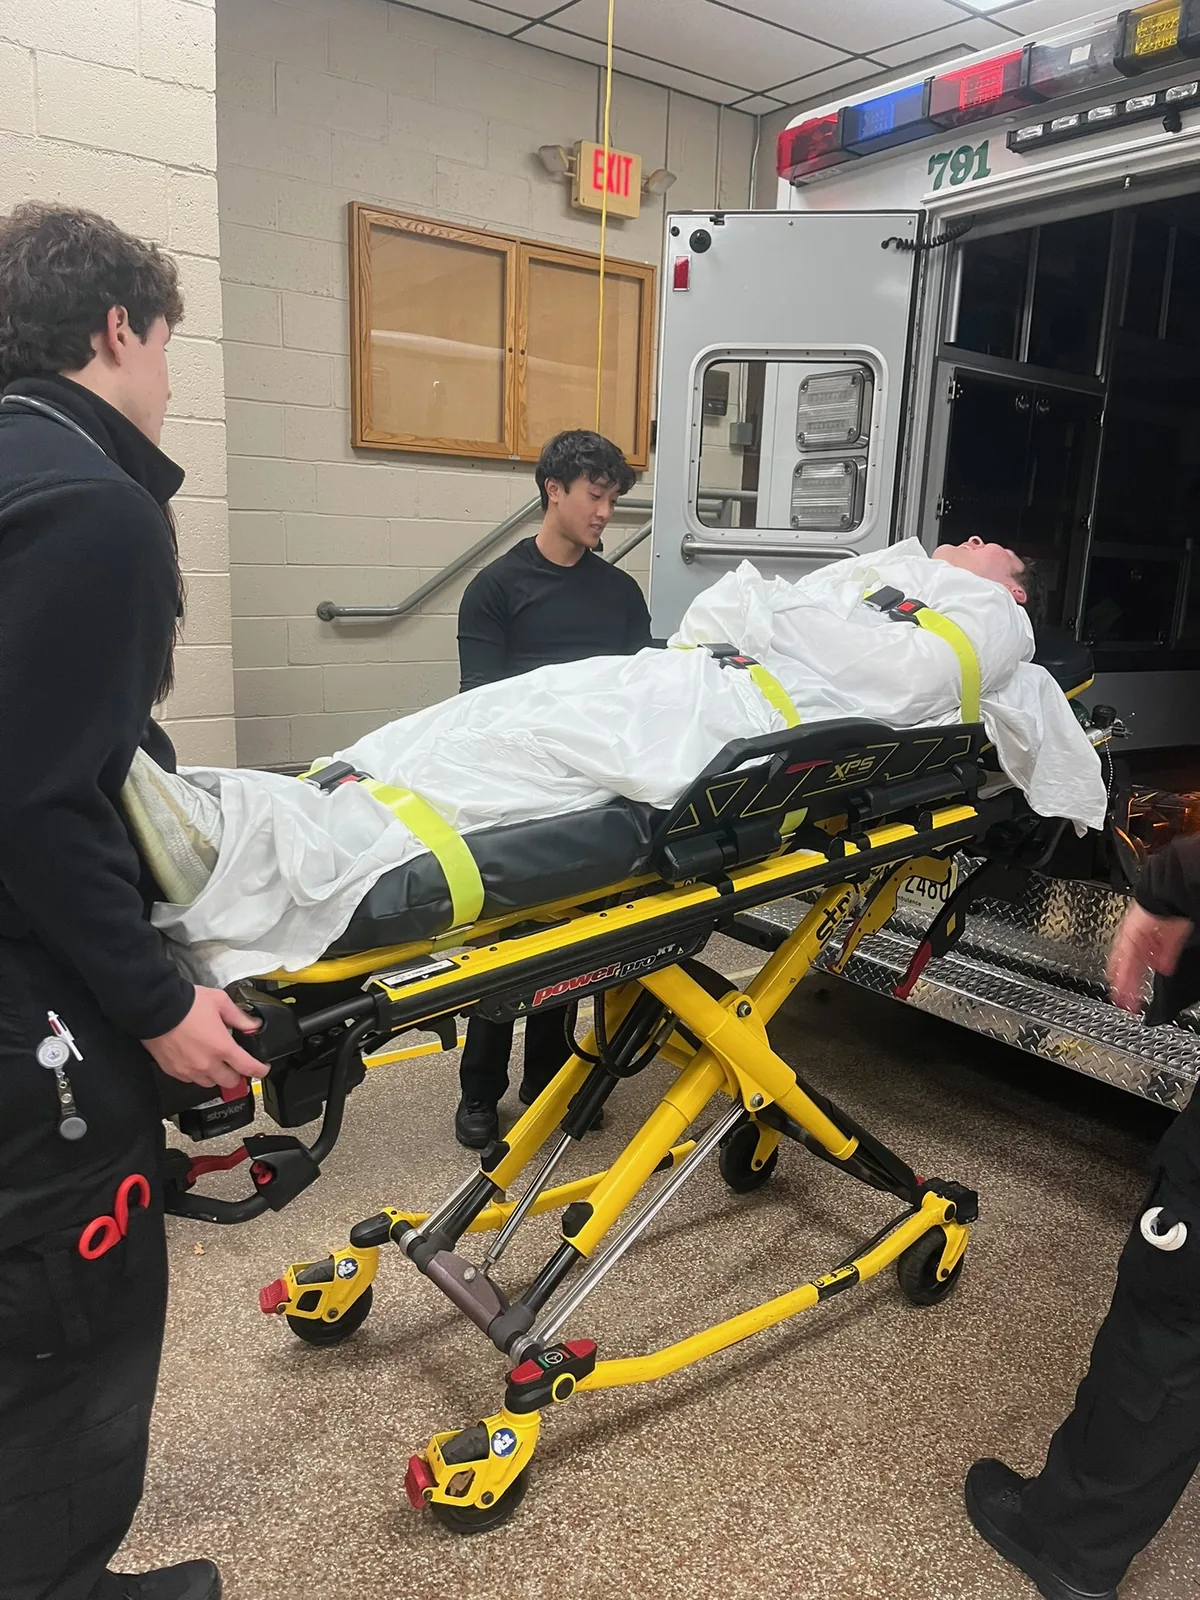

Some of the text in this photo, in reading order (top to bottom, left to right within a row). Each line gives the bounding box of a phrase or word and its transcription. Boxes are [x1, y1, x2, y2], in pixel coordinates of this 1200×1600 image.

[592, 148, 634, 198] EXIT
[927, 139, 991, 191] 791
[828, 755, 876, 780] XPS
[206, 1102, 246, 1122] stryker
